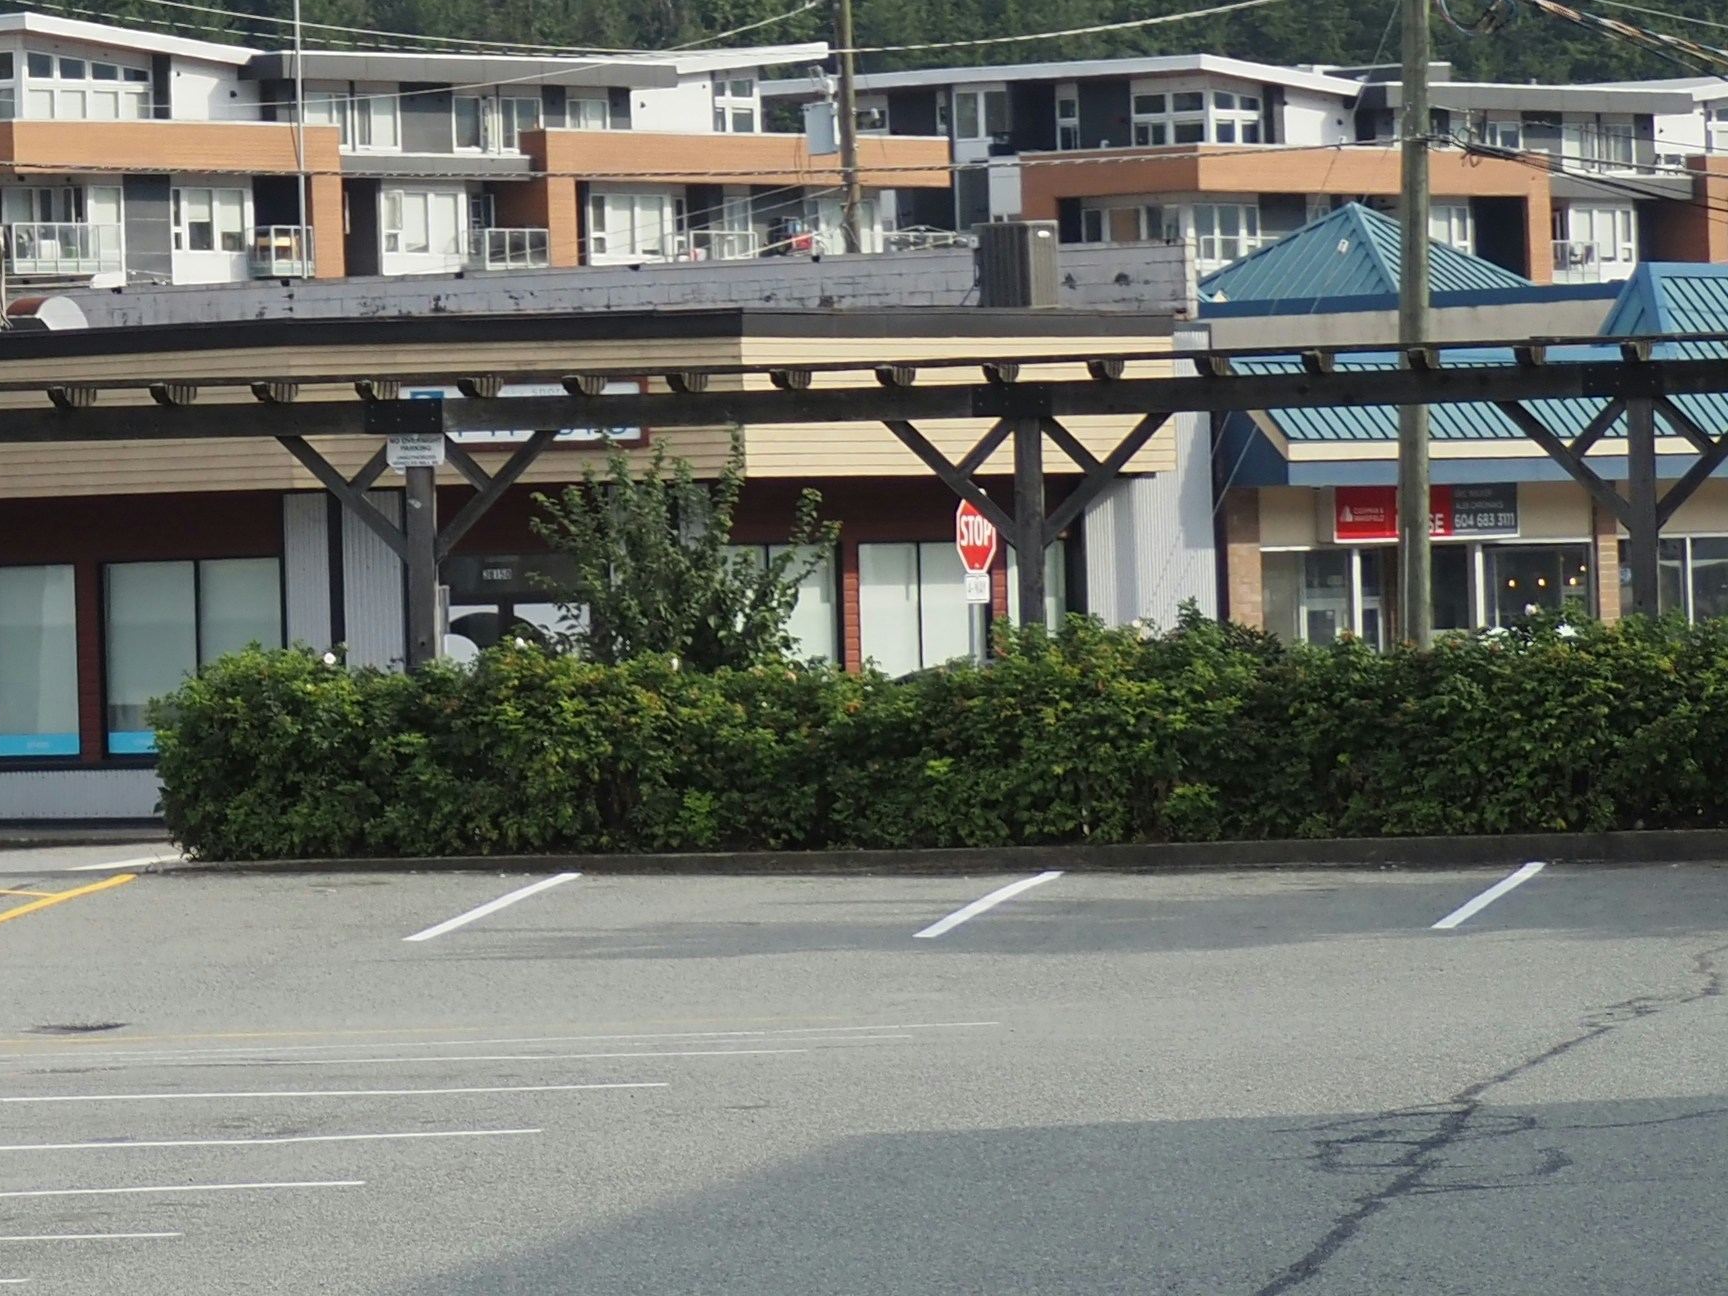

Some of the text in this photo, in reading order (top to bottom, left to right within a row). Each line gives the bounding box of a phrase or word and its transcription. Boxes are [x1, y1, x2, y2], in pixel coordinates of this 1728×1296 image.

[960, 515, 992, 546] STOP
[1455, 513, 1474, 528] 604
[1476, 513, 1495, 527] 683
